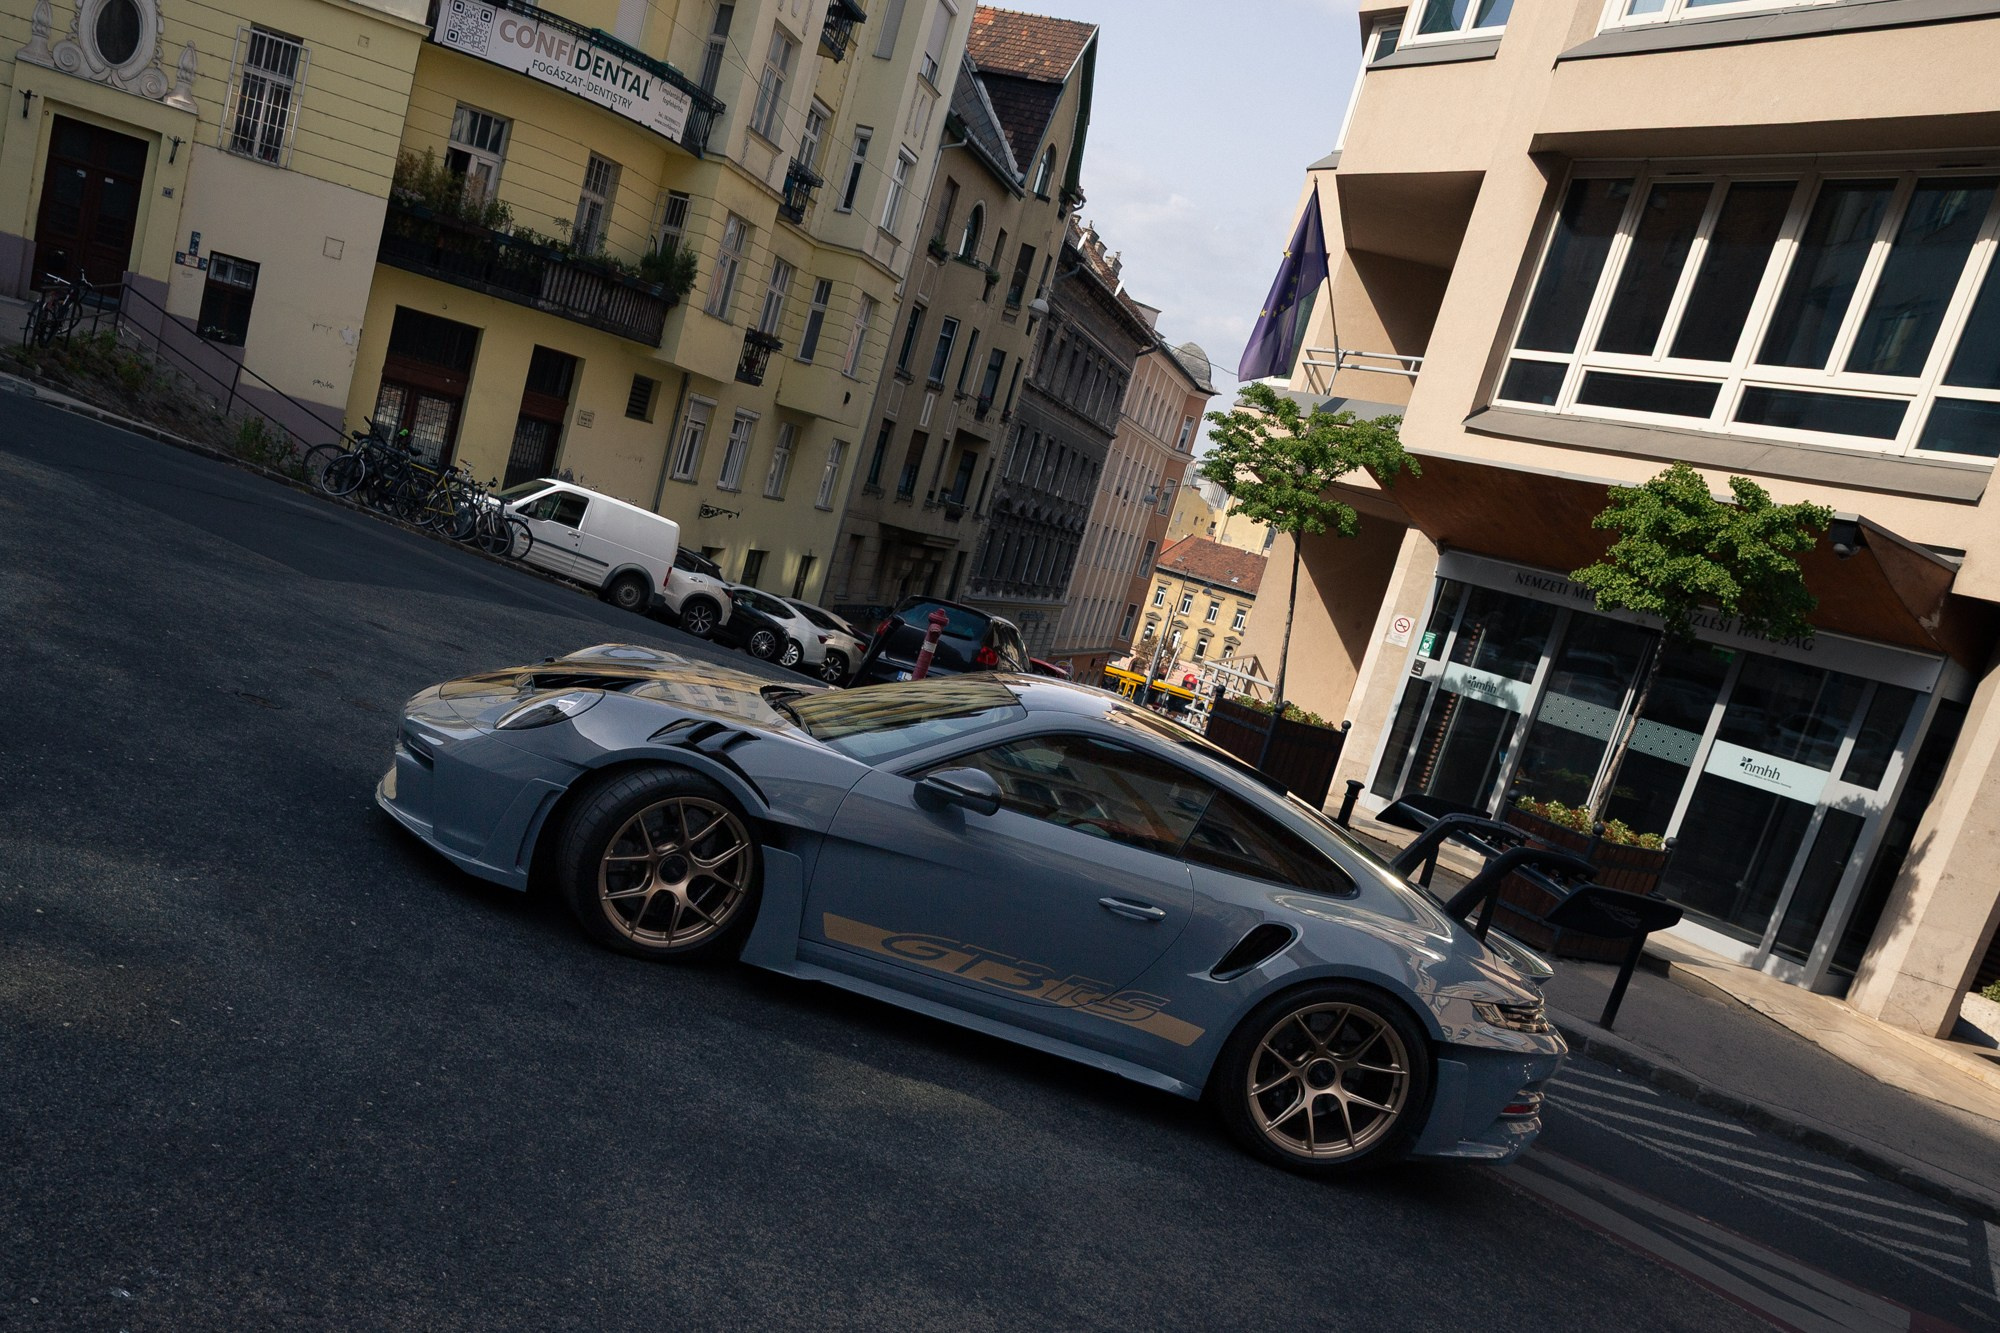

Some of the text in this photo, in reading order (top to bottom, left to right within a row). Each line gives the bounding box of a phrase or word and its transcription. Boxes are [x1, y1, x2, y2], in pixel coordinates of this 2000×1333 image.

[500, 20, 650, 101] CONFIDENTAL
[1515, 573, 1569, 595] NEMZETI
[1471, 681, 1497, 694] nmhh
[1744, 763, 1781, 781] nmhh
